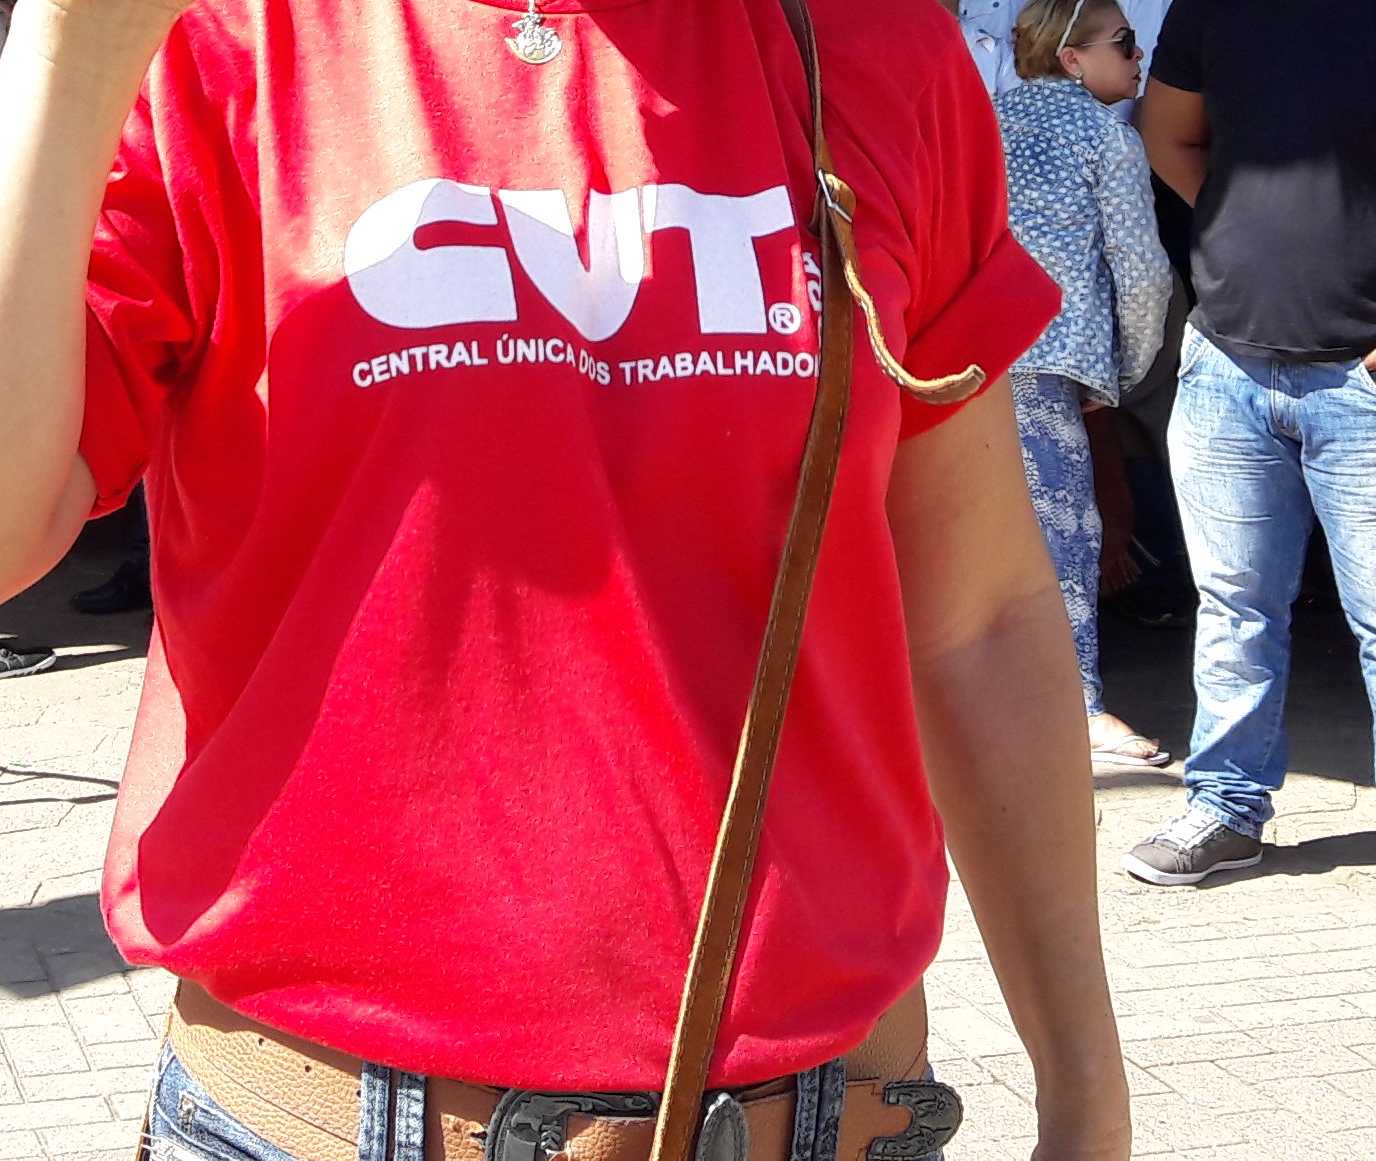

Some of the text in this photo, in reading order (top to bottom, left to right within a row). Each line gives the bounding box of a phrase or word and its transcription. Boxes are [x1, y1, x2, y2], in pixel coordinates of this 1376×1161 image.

[351, 333, 821, 389] CENTRAL ÚNICA DOS TRABALHADO
